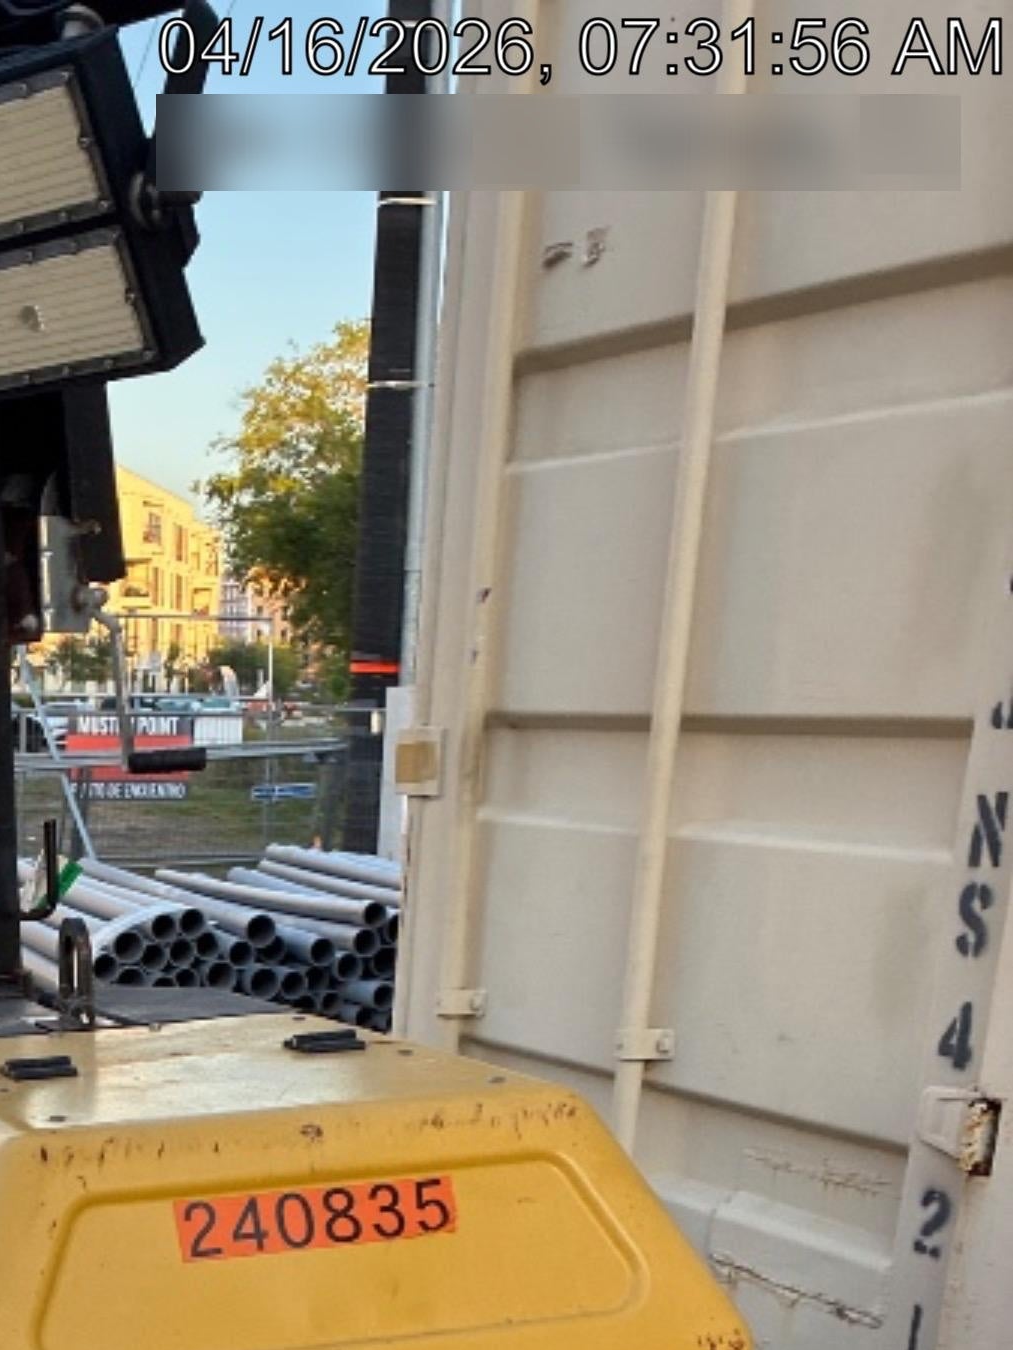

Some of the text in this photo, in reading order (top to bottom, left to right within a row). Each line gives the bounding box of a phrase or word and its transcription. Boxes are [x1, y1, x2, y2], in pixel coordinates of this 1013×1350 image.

[78, 716, 180, 736] MUST POINT
[183, 1178, 450, 1257] 240835
